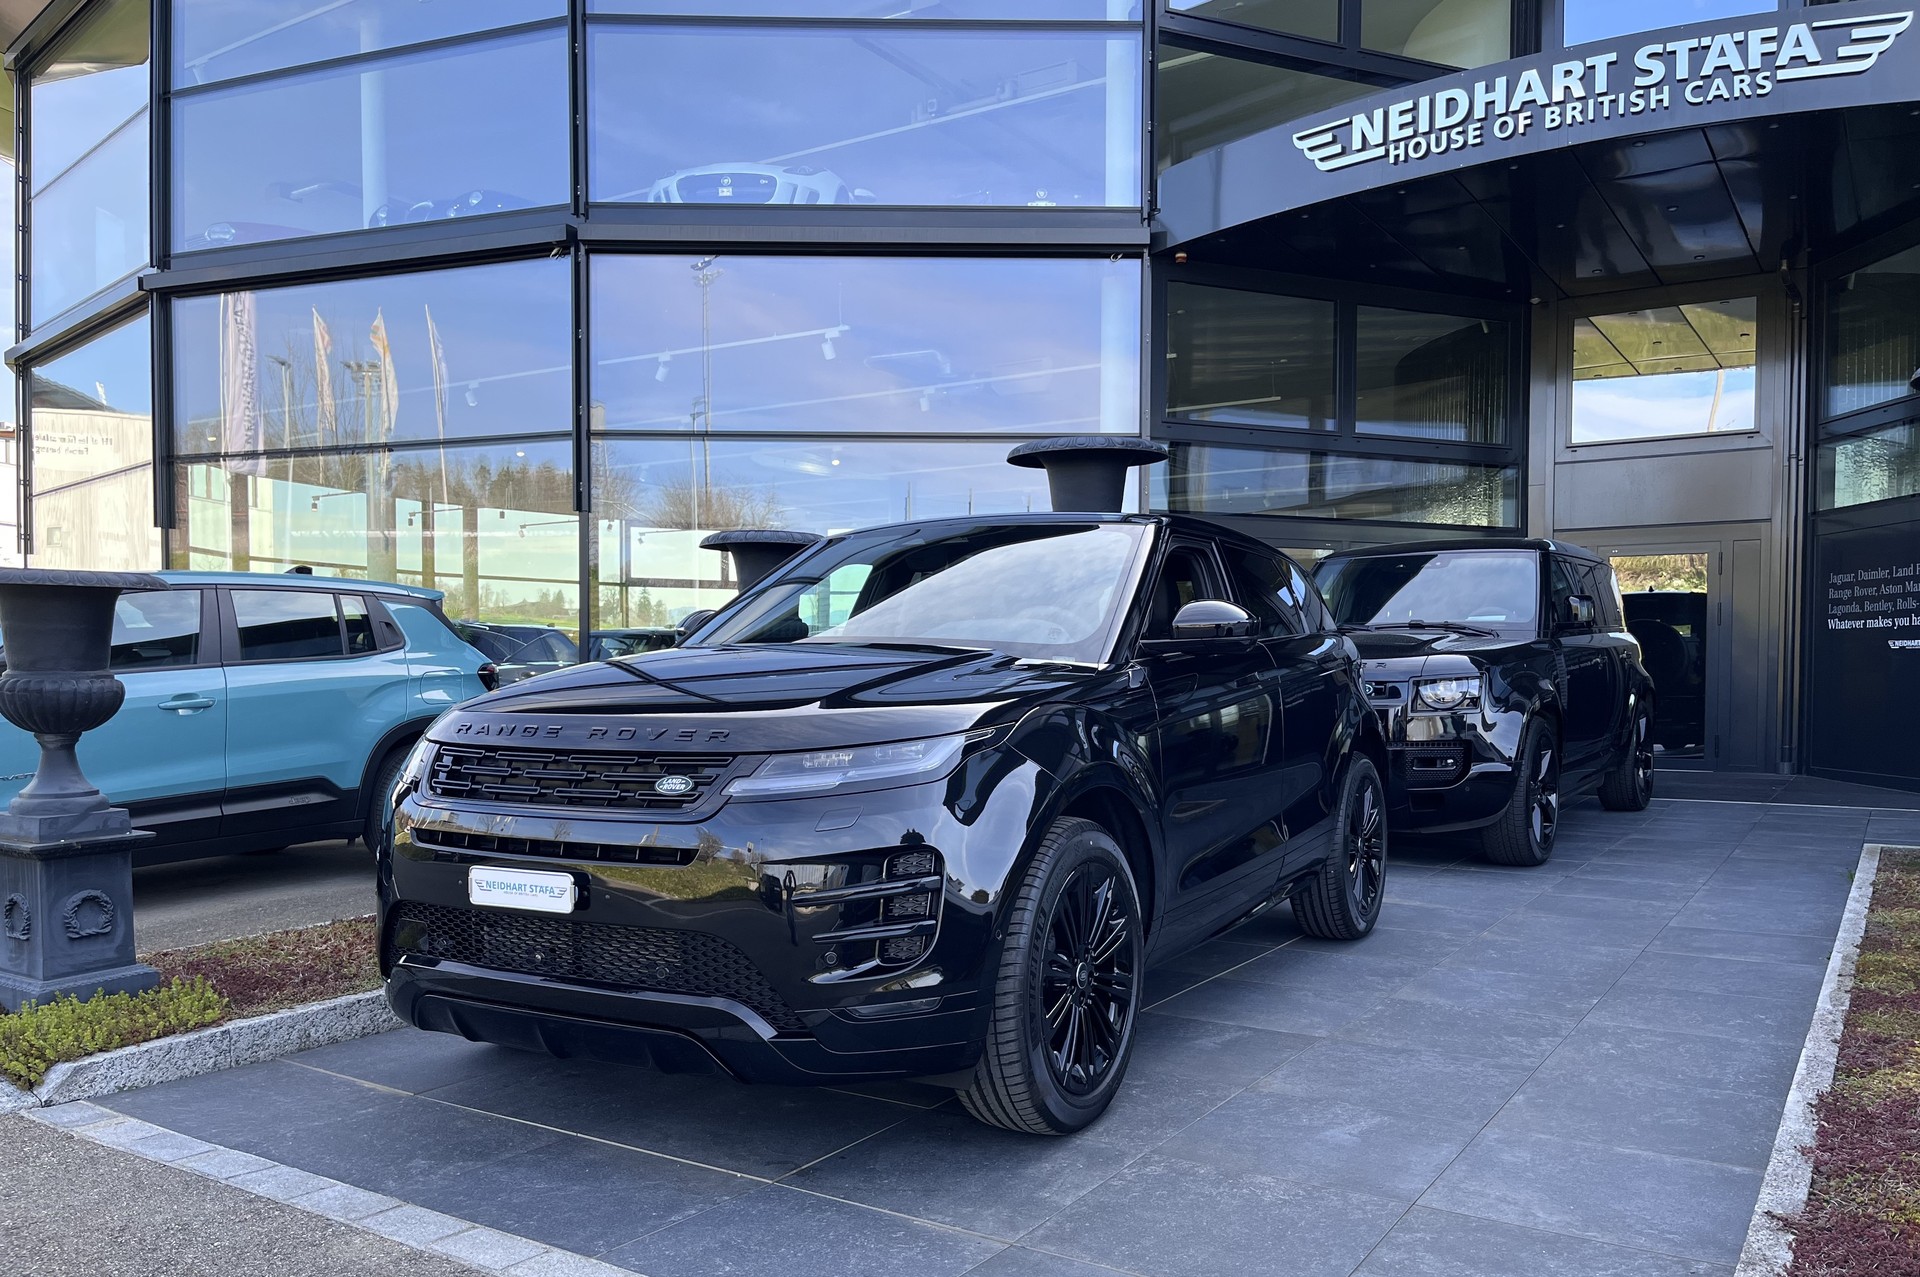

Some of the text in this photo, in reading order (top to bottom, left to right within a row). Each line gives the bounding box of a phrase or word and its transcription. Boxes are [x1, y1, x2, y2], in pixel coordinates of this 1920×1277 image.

[1352, 23, 1822, 150] NEIDHART STÄFA
[1388, 71, 1774, 163] HOUSE OF BRITISH CARS
[1829, 573, 1856, 585] Jaguar,
[1858, 567, 1891, 581] Daimler,
[1893, 563, 1914, 577] Land
[1829, 588, 1853, 600] Range
[1854, 585, 1878, 597] Rover,
[1879, 583, 1903, 595] Aston
[1864, 600, 1895, 613] Bentley,
[1828, 618, 1865, 630] Whatever
[1866, 615, 1893, 628] makes
[1894, 617, 1910, 629] you
[455, 722, 730, 742] RANGE ROVER
[485, 880, 556, 895] NEIDHART STÄFA
